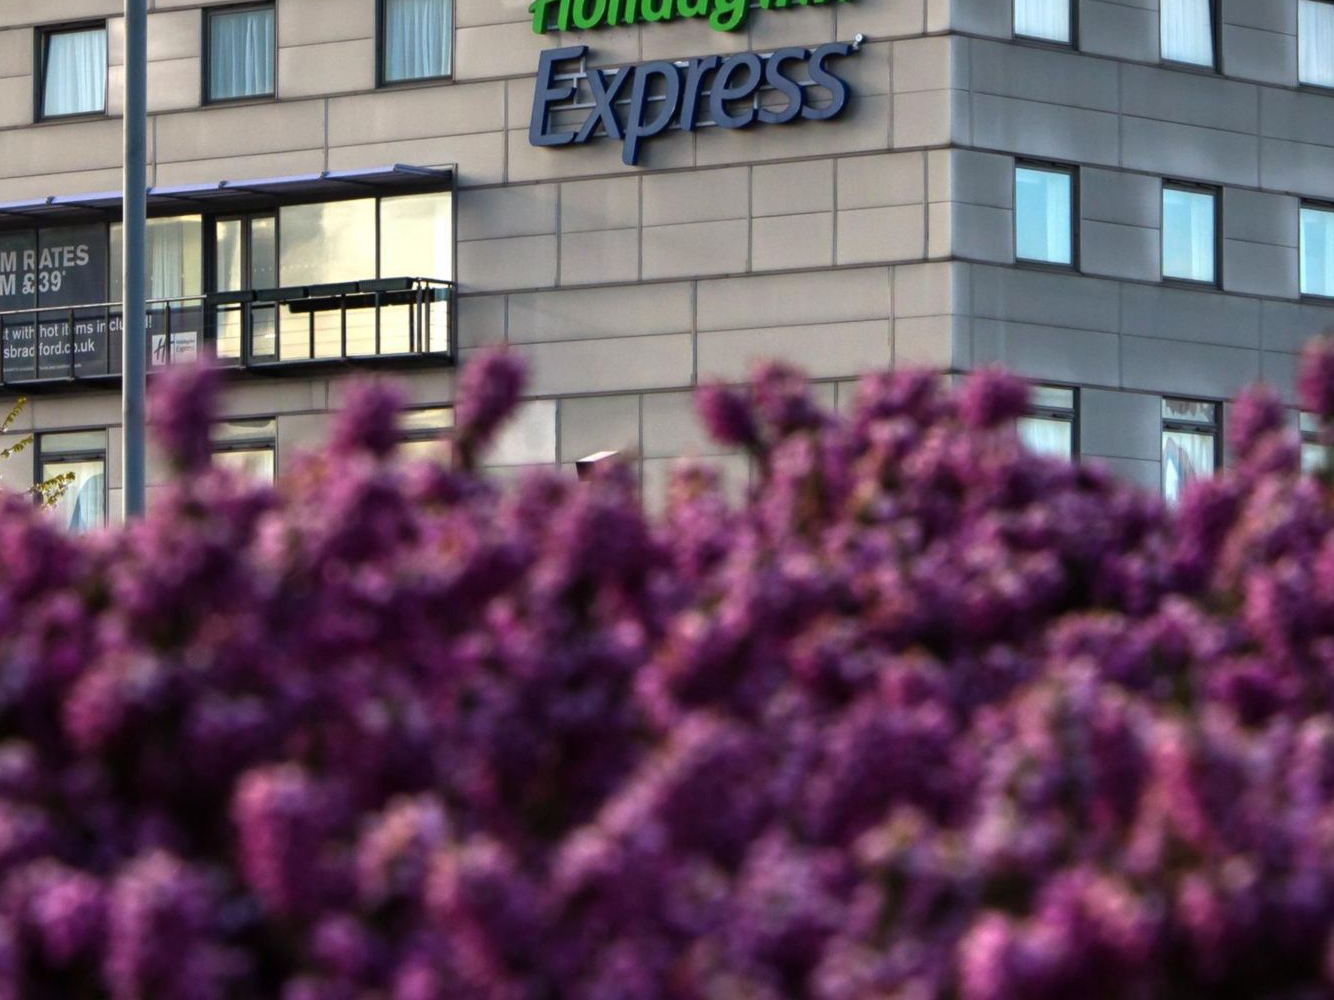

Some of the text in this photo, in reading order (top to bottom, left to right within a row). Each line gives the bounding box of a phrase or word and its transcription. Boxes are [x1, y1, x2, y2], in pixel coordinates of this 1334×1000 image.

[528, 41, 853, 166] Express
[23, 244, 89, 271] RATES
[12, 324, 36, 340] with
[39, 323, 59, 338] hot
[61, 321, 94, 336] itms
